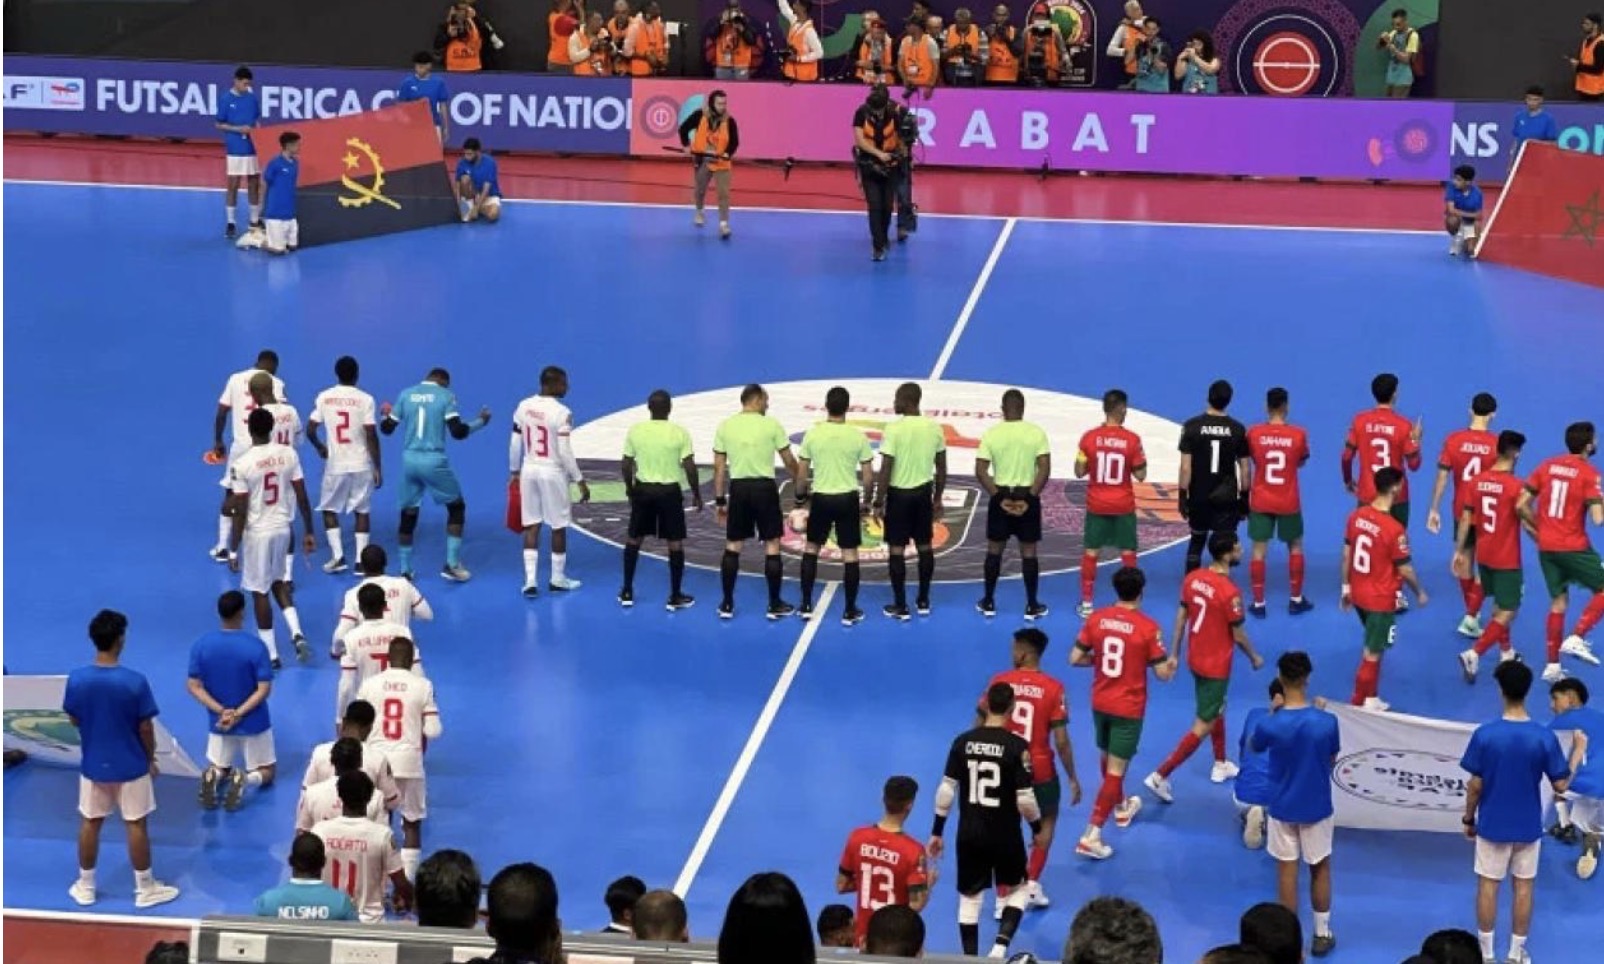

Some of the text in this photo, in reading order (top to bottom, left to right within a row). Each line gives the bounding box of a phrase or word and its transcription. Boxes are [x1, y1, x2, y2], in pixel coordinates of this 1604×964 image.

[261, 86, 363, 120] FRICA
[450, 92, 502, 126] OF
[914, 107, 1156, 153] RABAT
[336, 411, 351, 444] 2
[418, 405, 425, 440] 1
[526, 424, 549, 458] 13
[1210, 440, 1220, 473] 1
[1371, 438, 1390, 472] 3
[1096, 450, 1125, 486] 10
[1265, 450, 1286, 485] 2
[1462, 456, 1481, 481] 4
[264, 471, 279, 505] 5
[1548, 479, 1569, 519] 11
[1482, 496, 1497, 533] 5
[1353, 534, 1372, 574] 6
[1193, 596, 1206, 633] 7
[1102, 636, 1125, 678] 8
[383, 698, 403, 741] 8
[1011, 701, 1034, 742] 9
[967, 760, 1001, 807] 12
[331, 858, 357, 898] 11
[861, 863, 895, 911] 13
